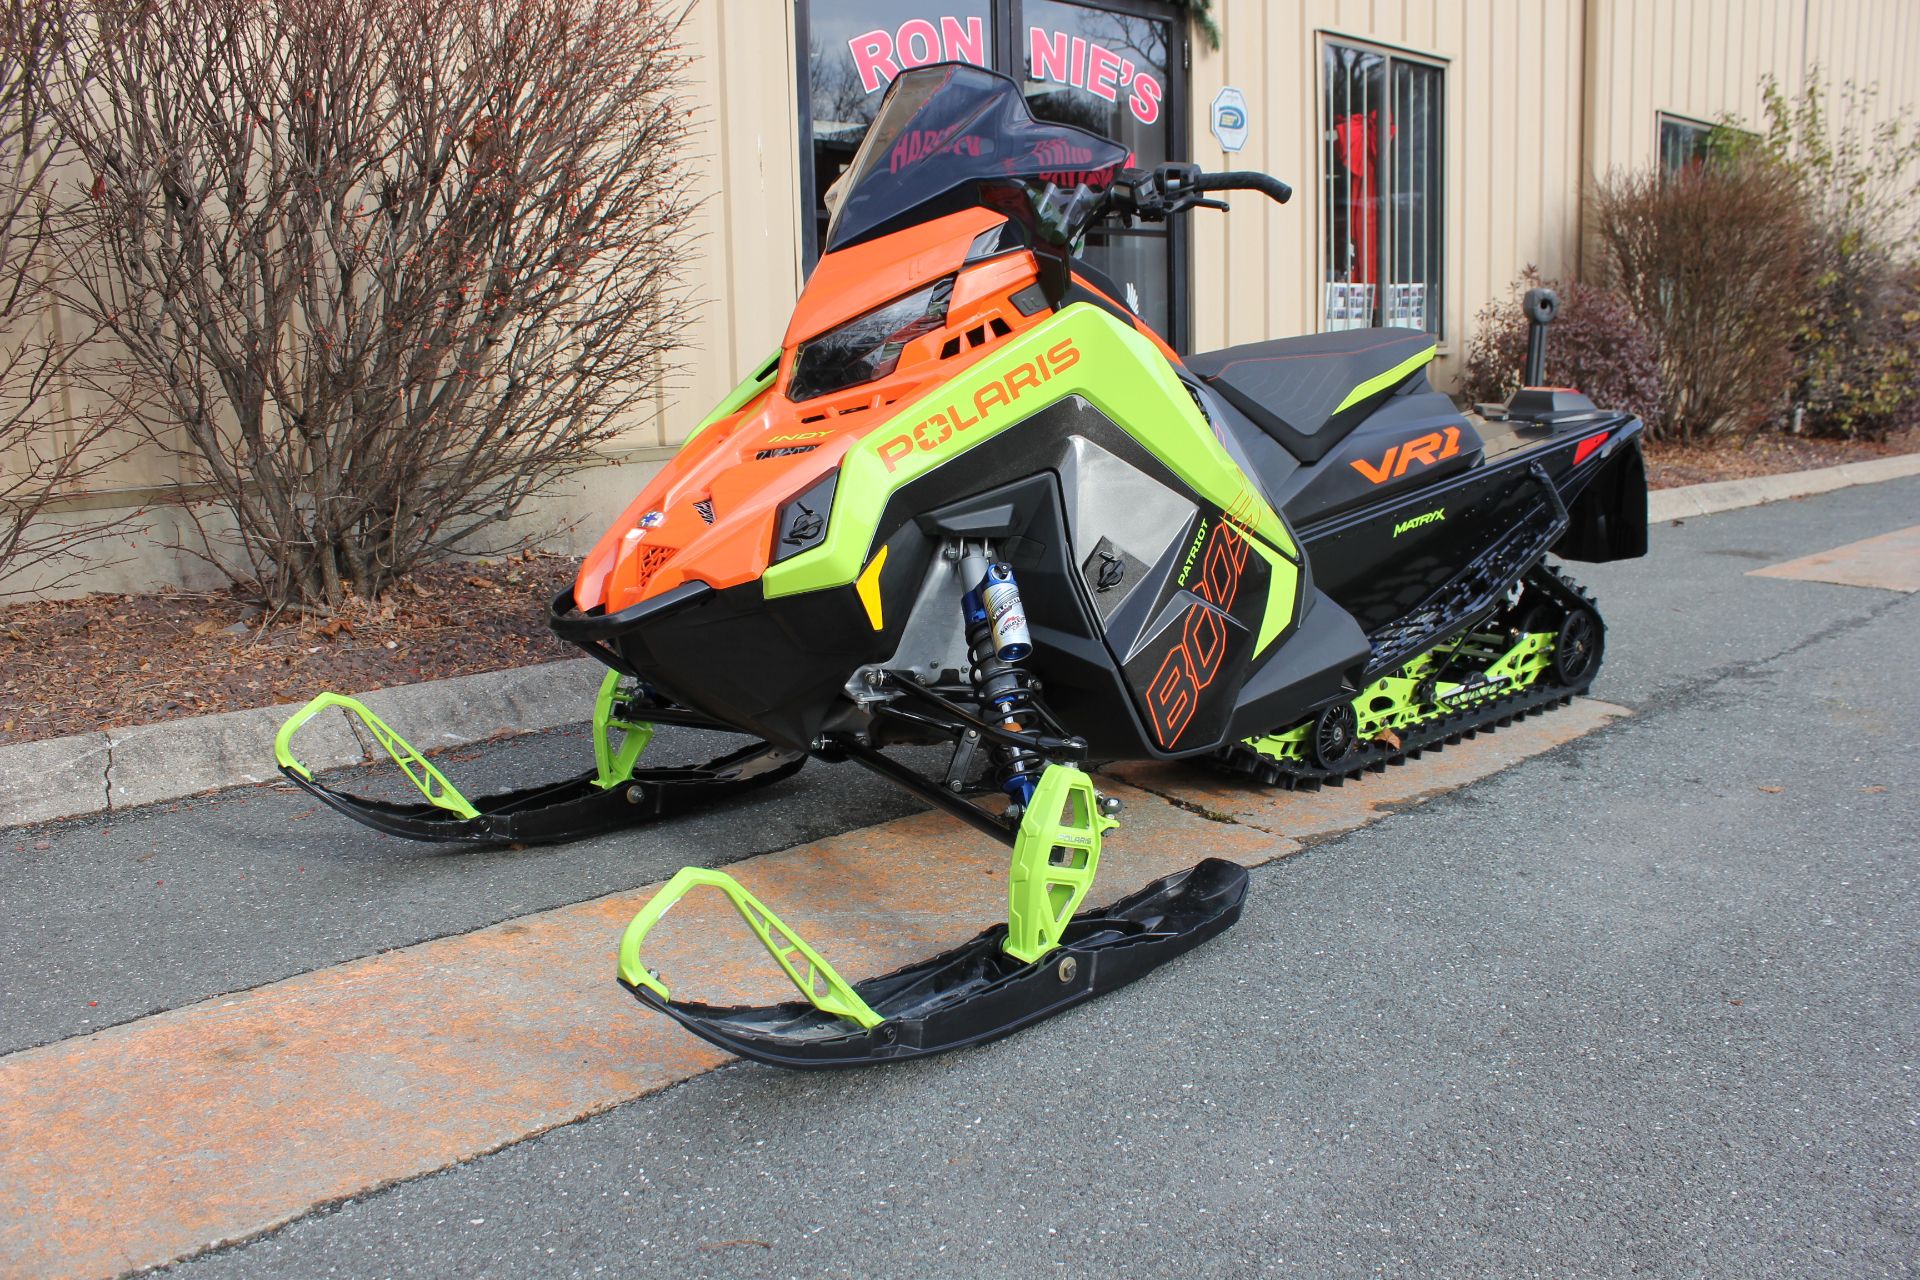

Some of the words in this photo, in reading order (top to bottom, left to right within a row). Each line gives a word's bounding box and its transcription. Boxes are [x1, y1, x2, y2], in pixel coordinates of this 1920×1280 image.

[848, 16, 985, 94] RON
[1029, 27, 1163, 125] NIE'S
[767, 429, 837, 443] INDY
[877, 337, 1080, 473] POLARIS
[1349, 426, 1461, 485] VR1
[1177, 518, 1209, 587] PATRIOT
[1392, 508, 1446, 538] MATRYX
